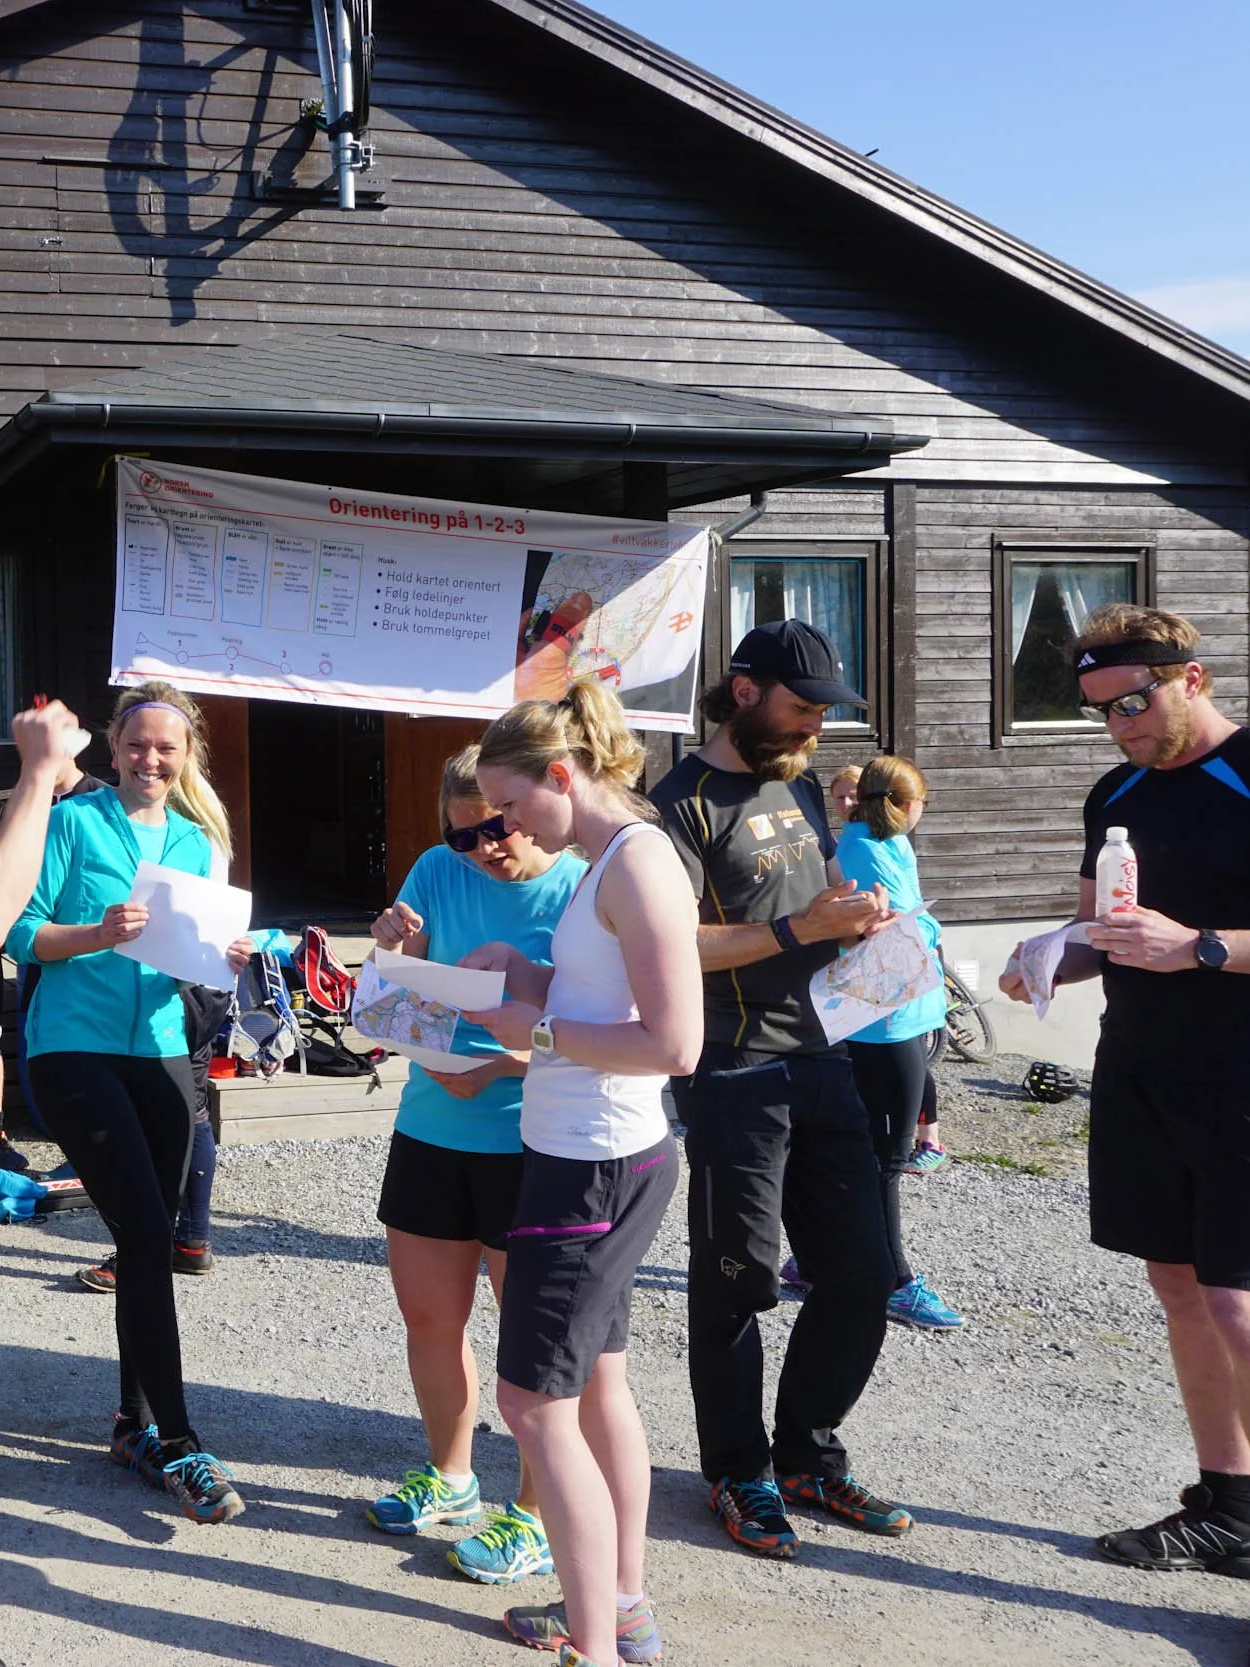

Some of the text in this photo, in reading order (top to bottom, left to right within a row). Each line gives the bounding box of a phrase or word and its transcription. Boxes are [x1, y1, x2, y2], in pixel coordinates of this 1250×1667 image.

[328, 497, 526, 535] Orientering på 1-2-3
[386, 571, 501, 593] Hold kartet orientert
[385, 586, 466, 606] Følg ledelinjer
[383, 603, 488, 624] Bruk holdepunkter
[381, 619, 491, 640] Bruk tommelgrepet
